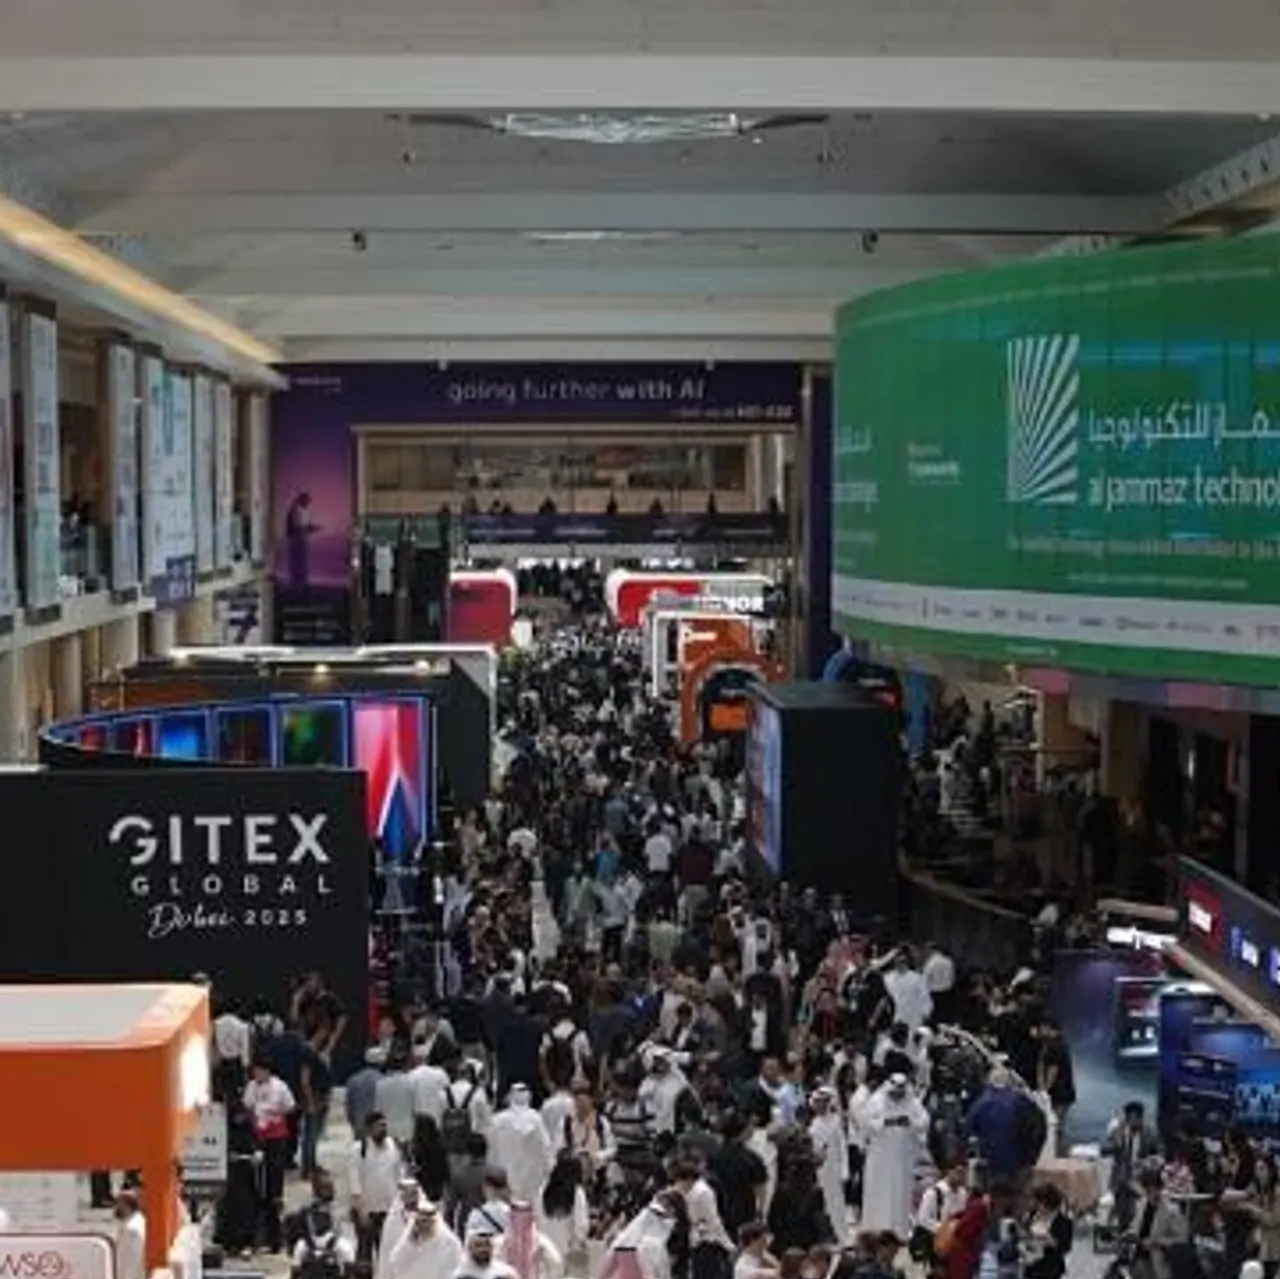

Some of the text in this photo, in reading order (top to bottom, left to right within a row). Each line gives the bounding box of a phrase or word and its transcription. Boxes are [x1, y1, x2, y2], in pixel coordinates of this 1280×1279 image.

[447, 378, 706, 404] going further with AI
[109, 814, 330, 866] GITEX
[131, 873, 334, 896] GLOBAL
[243, 908, 308, 926] 2025
